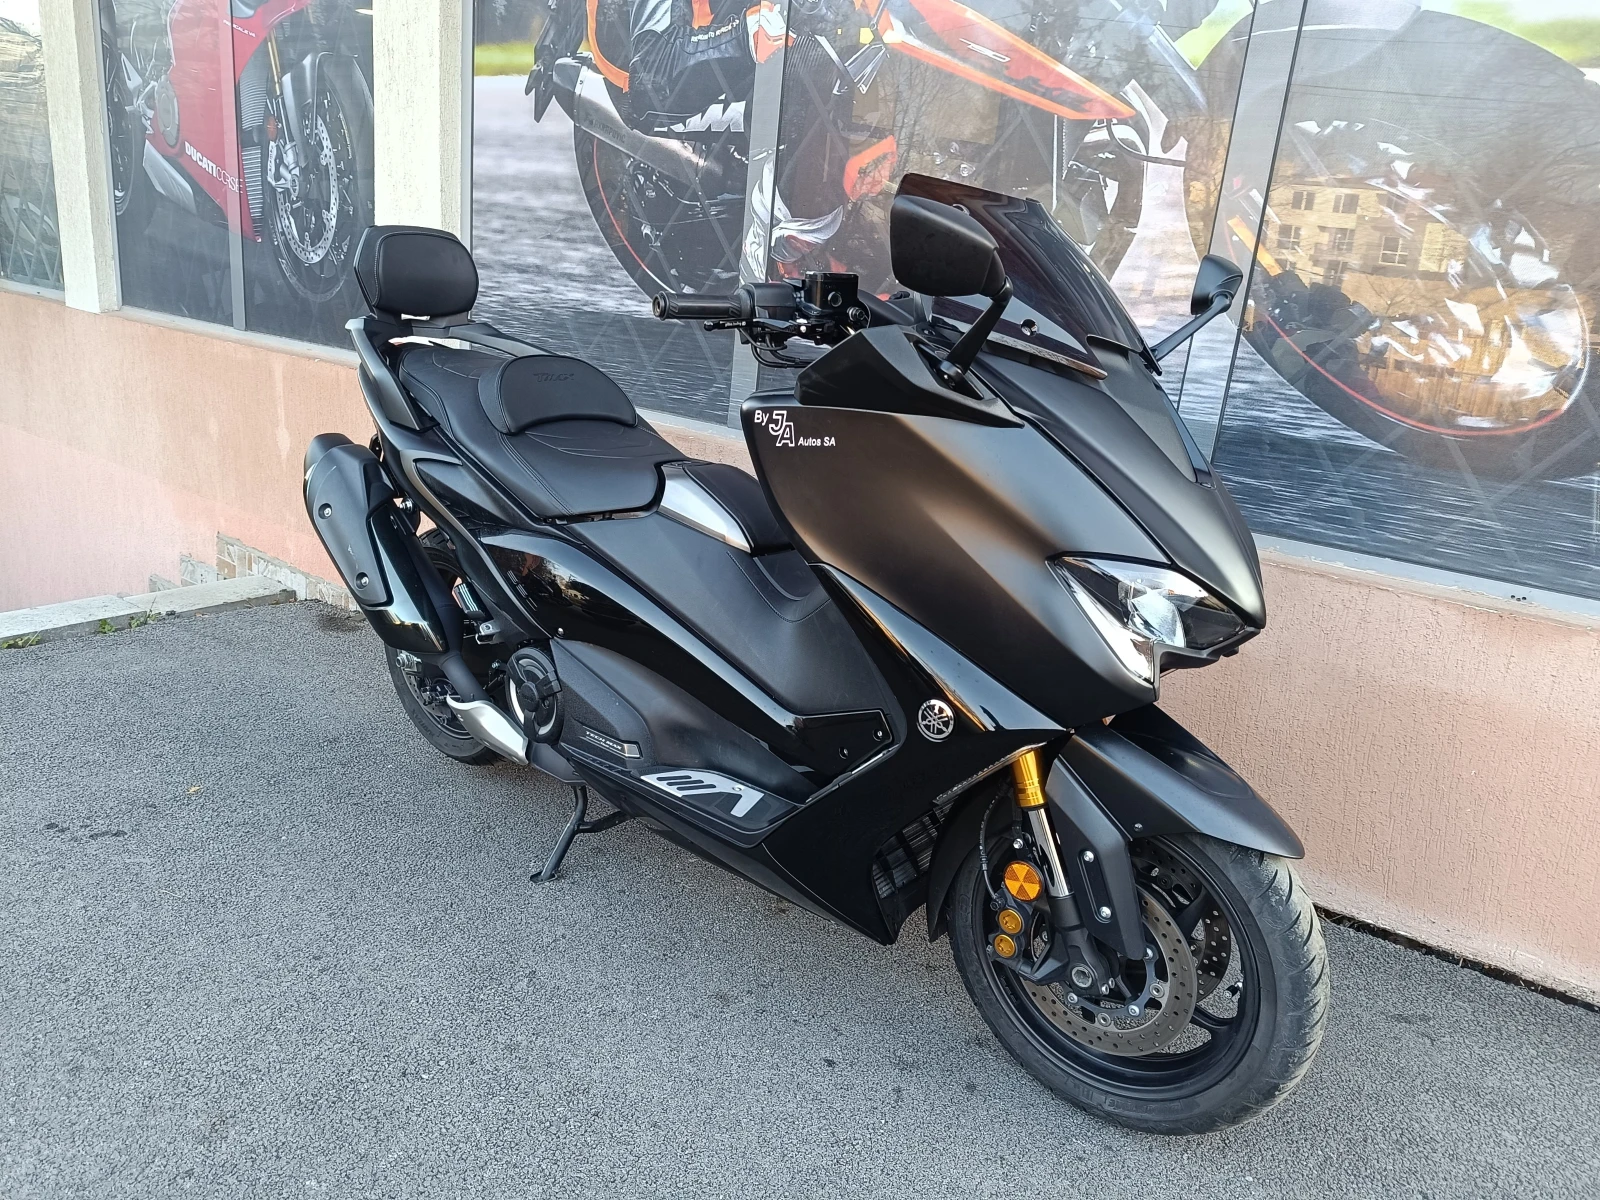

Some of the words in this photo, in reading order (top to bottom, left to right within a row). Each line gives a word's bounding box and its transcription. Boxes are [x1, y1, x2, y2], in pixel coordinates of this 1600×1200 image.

[184, 140, 217, 178] DUCATI
[754, 409, 769, 426] By
[768, 410, 795, 447] JA
[797, 436, 821, 447] Autos
[823, 436, 836, 447] SA
[606, 741, 622, 750] MAX
